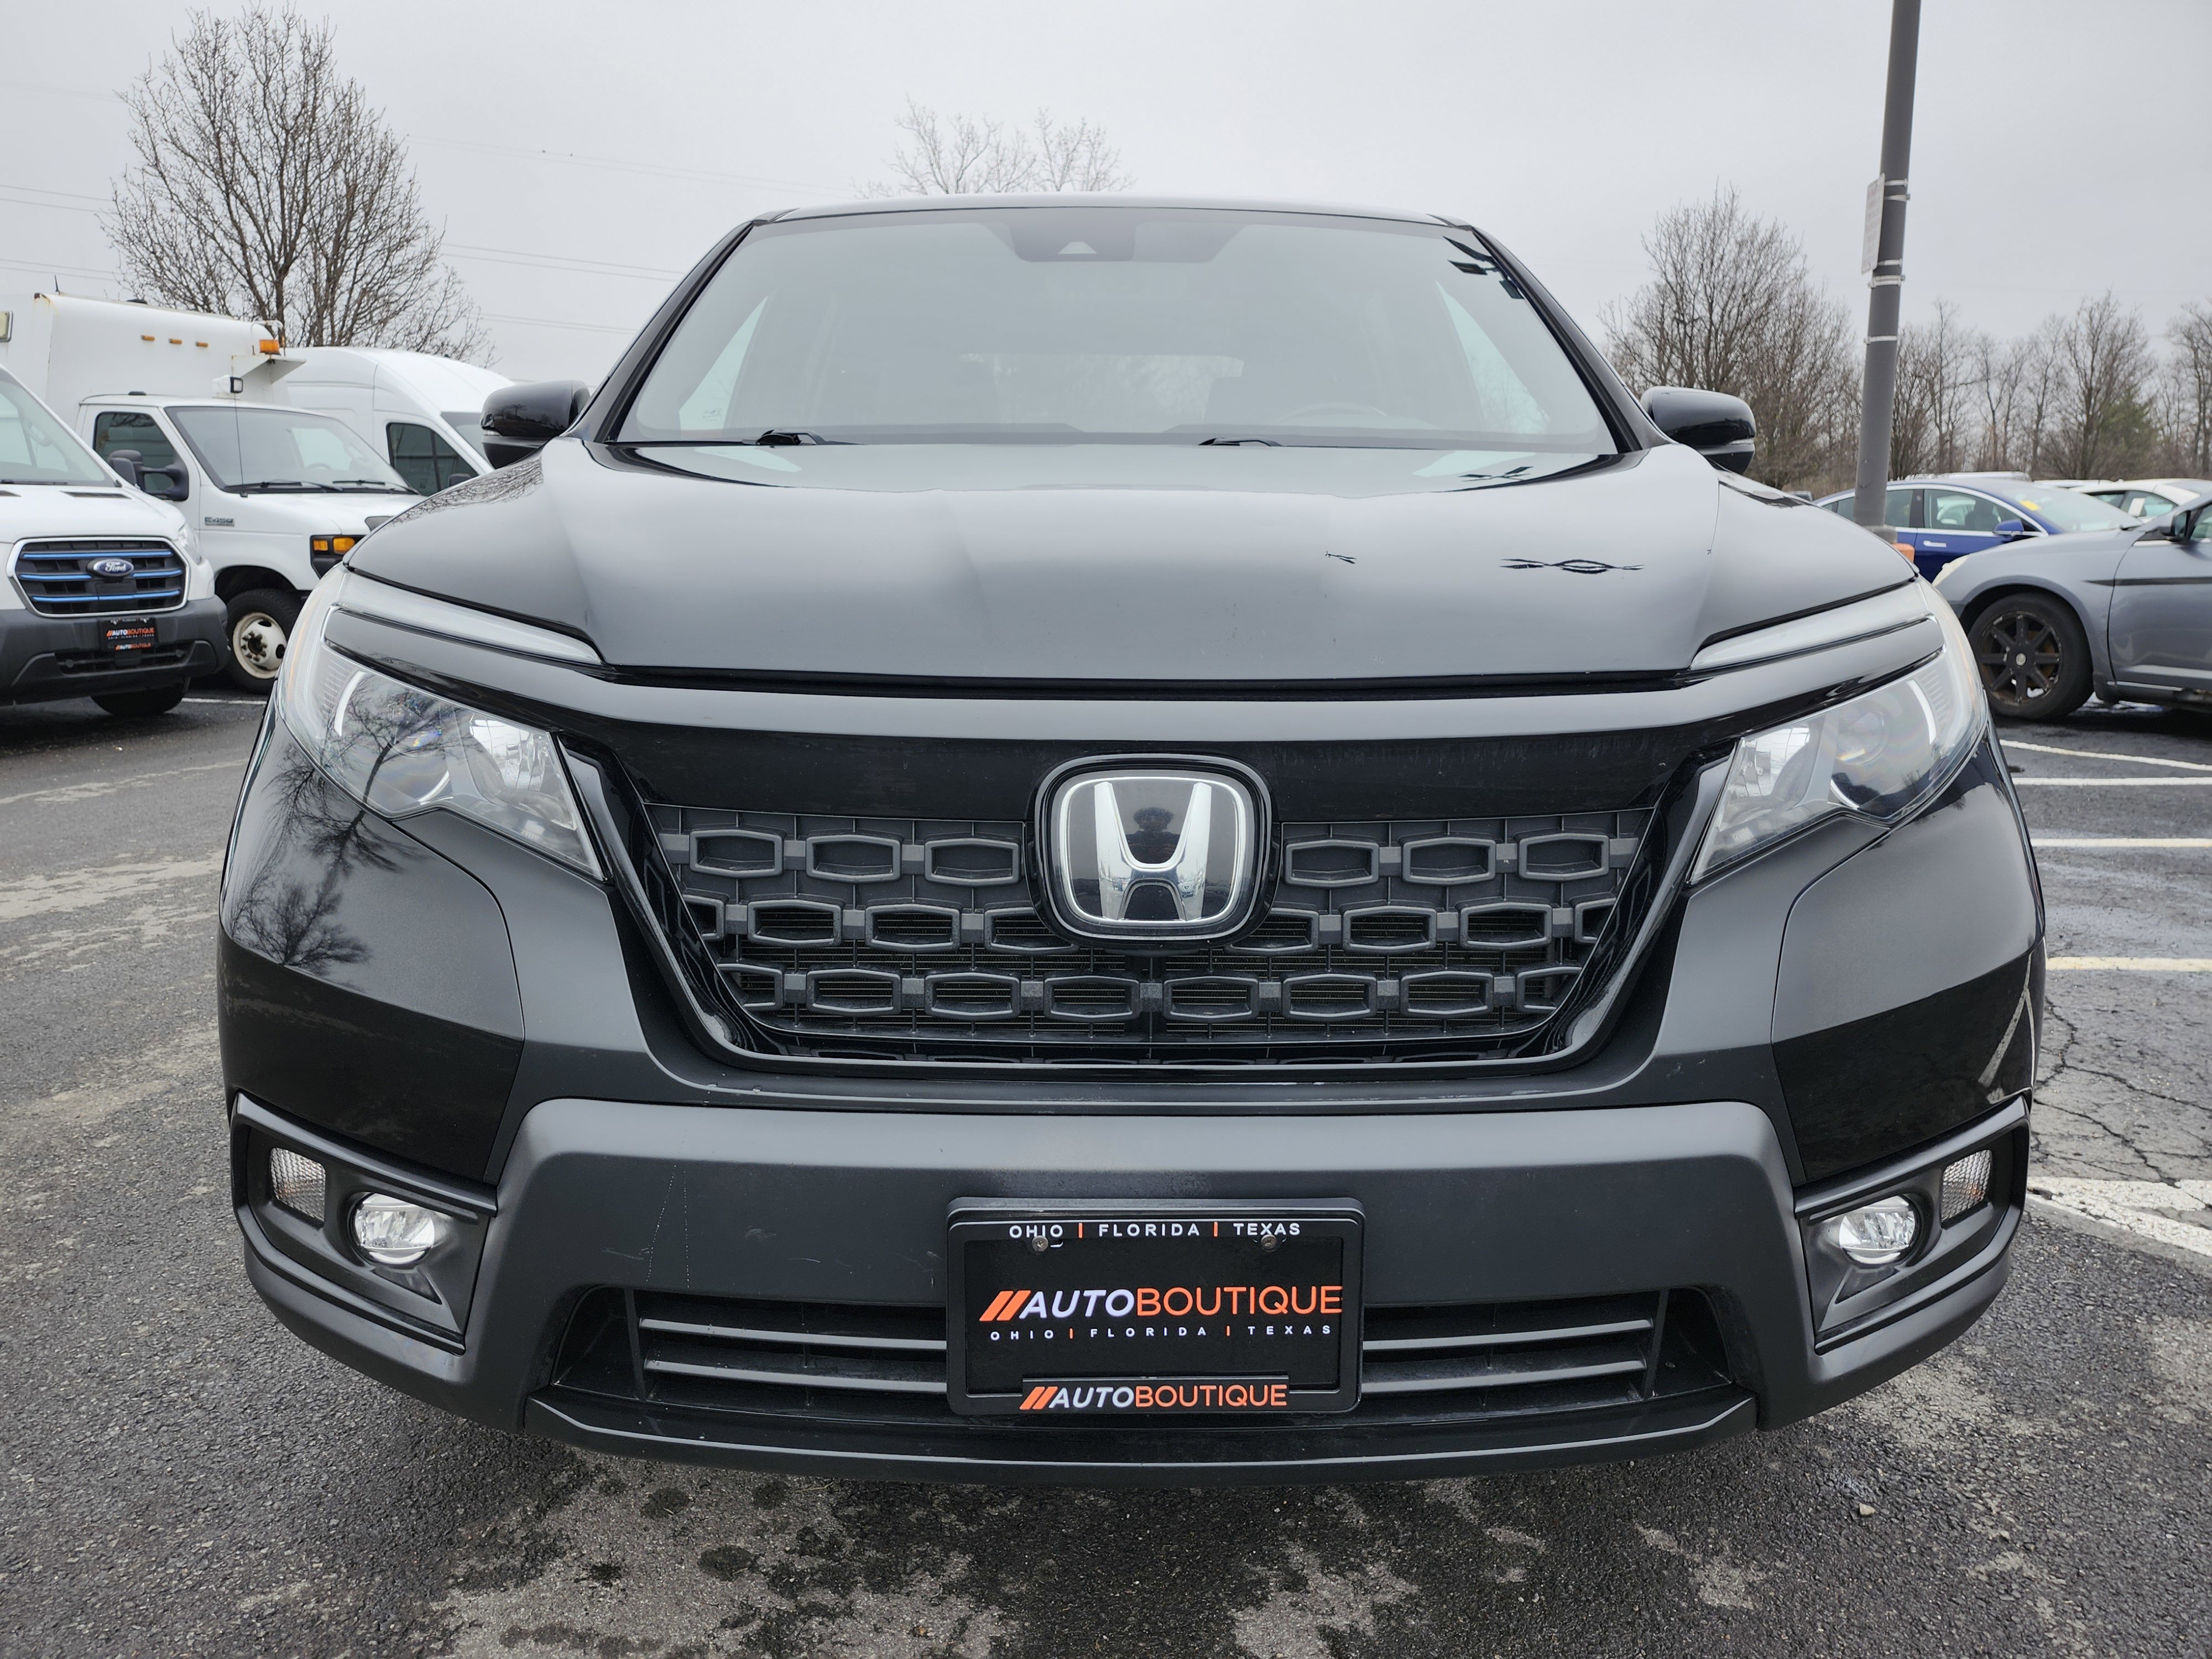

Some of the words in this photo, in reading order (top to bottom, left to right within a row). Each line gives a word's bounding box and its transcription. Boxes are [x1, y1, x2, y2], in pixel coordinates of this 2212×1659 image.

[105, 561, 127, 572] Ford
[1009, 1224, 1063, 1239] OHIO
[1098, 1223, 1201, 1237] FLORIDA
[1234, 1223, 1301, 1236] TEXAS
[1018, 1286, 1343, 1319] AUTOBOUTIQUE
[990, 1331, 1054, 1341] OHIO
[1090, 1327, 1207, 1338] FLORIDA
[1248, 1325, 1331, 1335] TEXAS
[1048, 1385, 1288, 1409] AUTOBOUTIQUE
